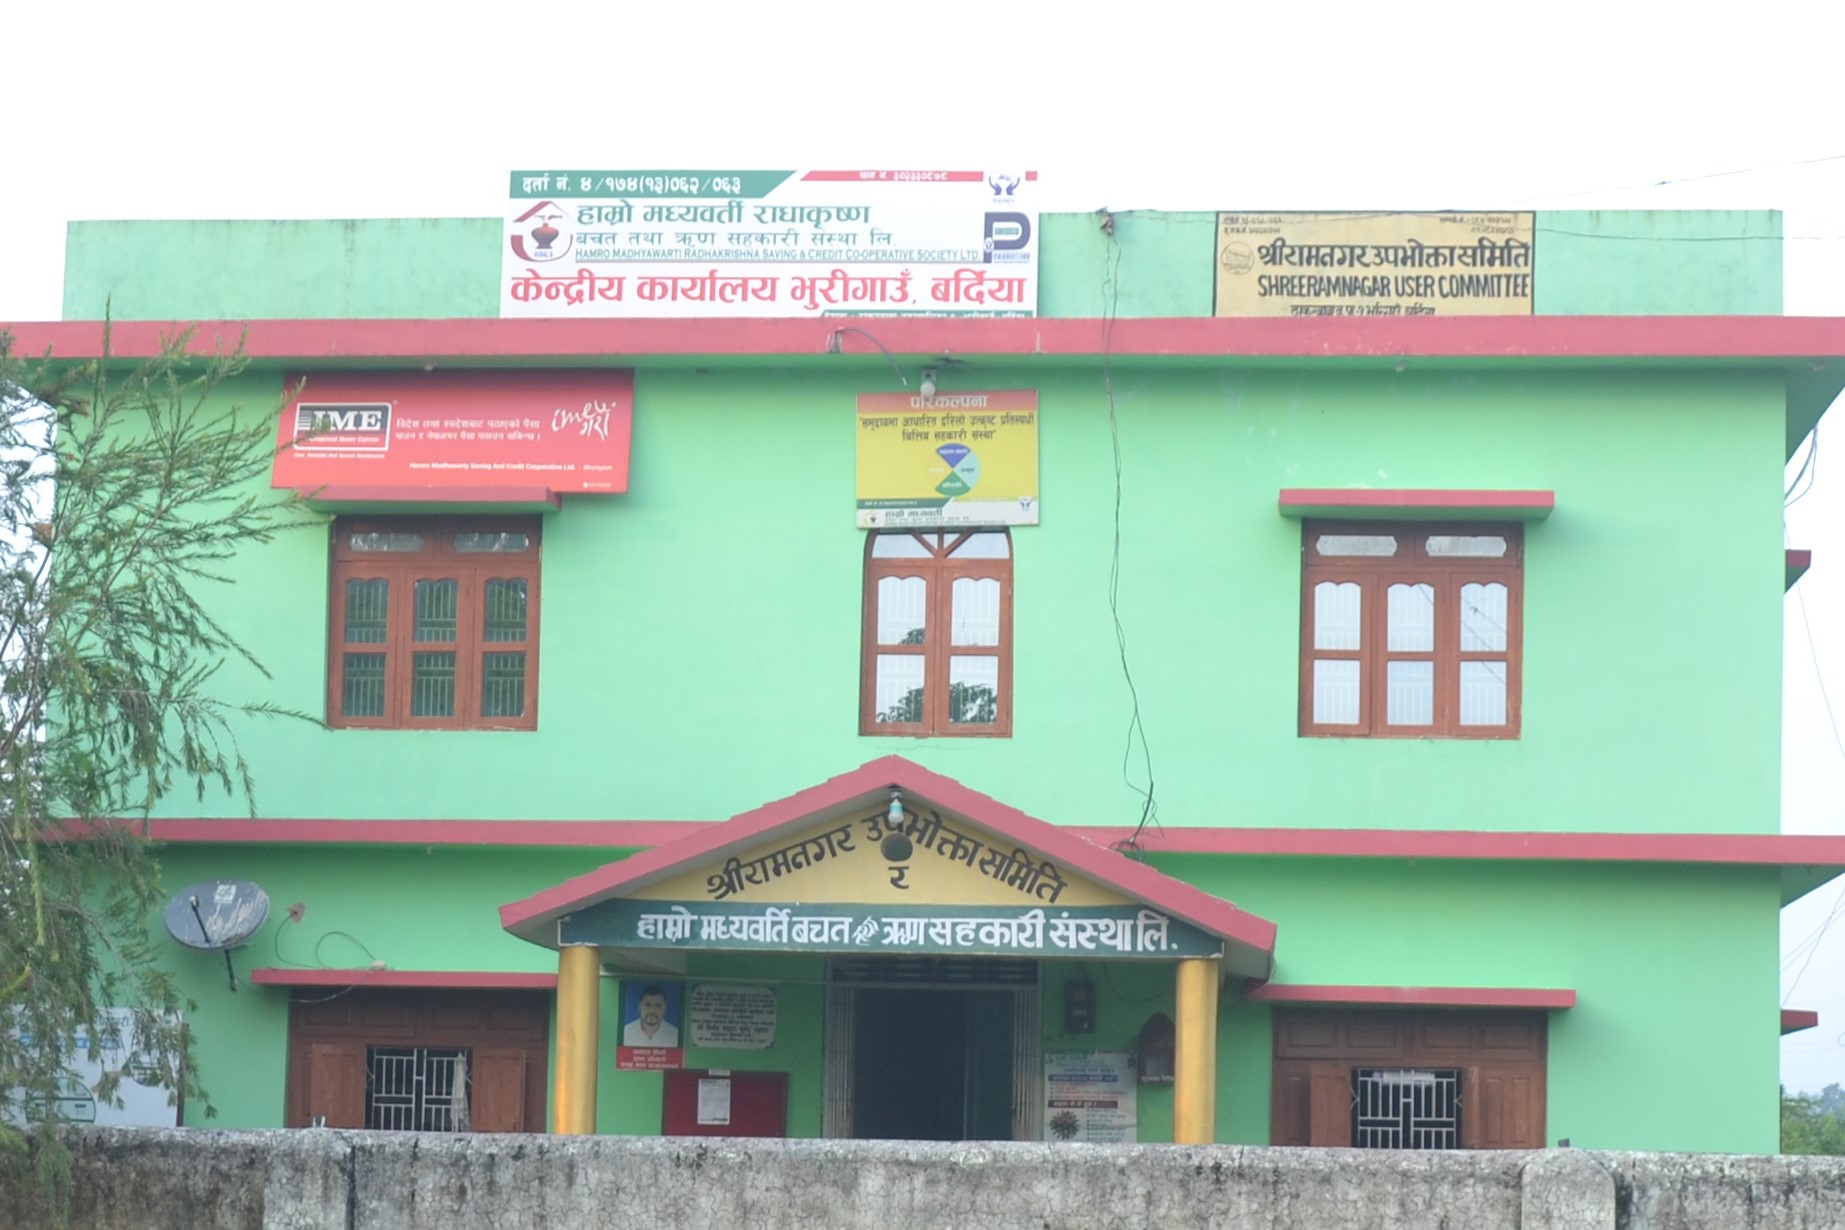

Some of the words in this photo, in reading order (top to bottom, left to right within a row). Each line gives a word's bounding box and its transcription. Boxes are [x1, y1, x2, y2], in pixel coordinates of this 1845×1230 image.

[522, 172, 550, 194] दर्ता
[577, 199, 634, 226] हाम्रो
[643, 199, 745, 225] मध्यवर्ती
[754, 204, 871, 229] राधाकृष्ण
[575, 232, 618, 245] बचत
[628, 232, 664, 245] तथा
[674, 232, 717, 247] ऋण
[727, 228, 800, 247] सहकारी
[811, 228, 858, 247] संस्था
[576, 249, 610, 260] HAMRO
[612, 249, 682, 260] MADHYAWARTI
[684, 249, 760, 260] RADHAKRISHNA
[762, 249, 797, 260] SAVING
[809, 249, 842, 260] CREDIT
[846, 249, 914, 260] CO-OPERATIVE
[917, 249, 957, 260] SOCIETY
[1458, 236, 1530, 268] समिति
[510, 268, 626, 306] केन्द्रीय
[637, 268, 780, 303] कार्यालय
[930, 268, 1027, 304] बर्दिया
[1257, 274, 1390, 298] SHREERAMNAGAR
[1394, 274, 1436, 298] USER
[1438, 273, 1530, 298] COMMITTEE
[312, 411, 382, 431] IME
[706, 824, 855, 900] श्रीरामनगर
[978, 847, 1068, 904] समिति
[888, 866, 910, 890] र
[637, 906, 698, 943] हाम्रो
[700, 907, 792, 943] मध्यवर्ति
[791, 916, 853, 945] बचत
[881, 918, 930, 945] ऋण
[929, 908, 1046, 948] सहकारी
[1049, 911, 1135, 950] संस्था
[1137, 909, 1179, 952] लि.
